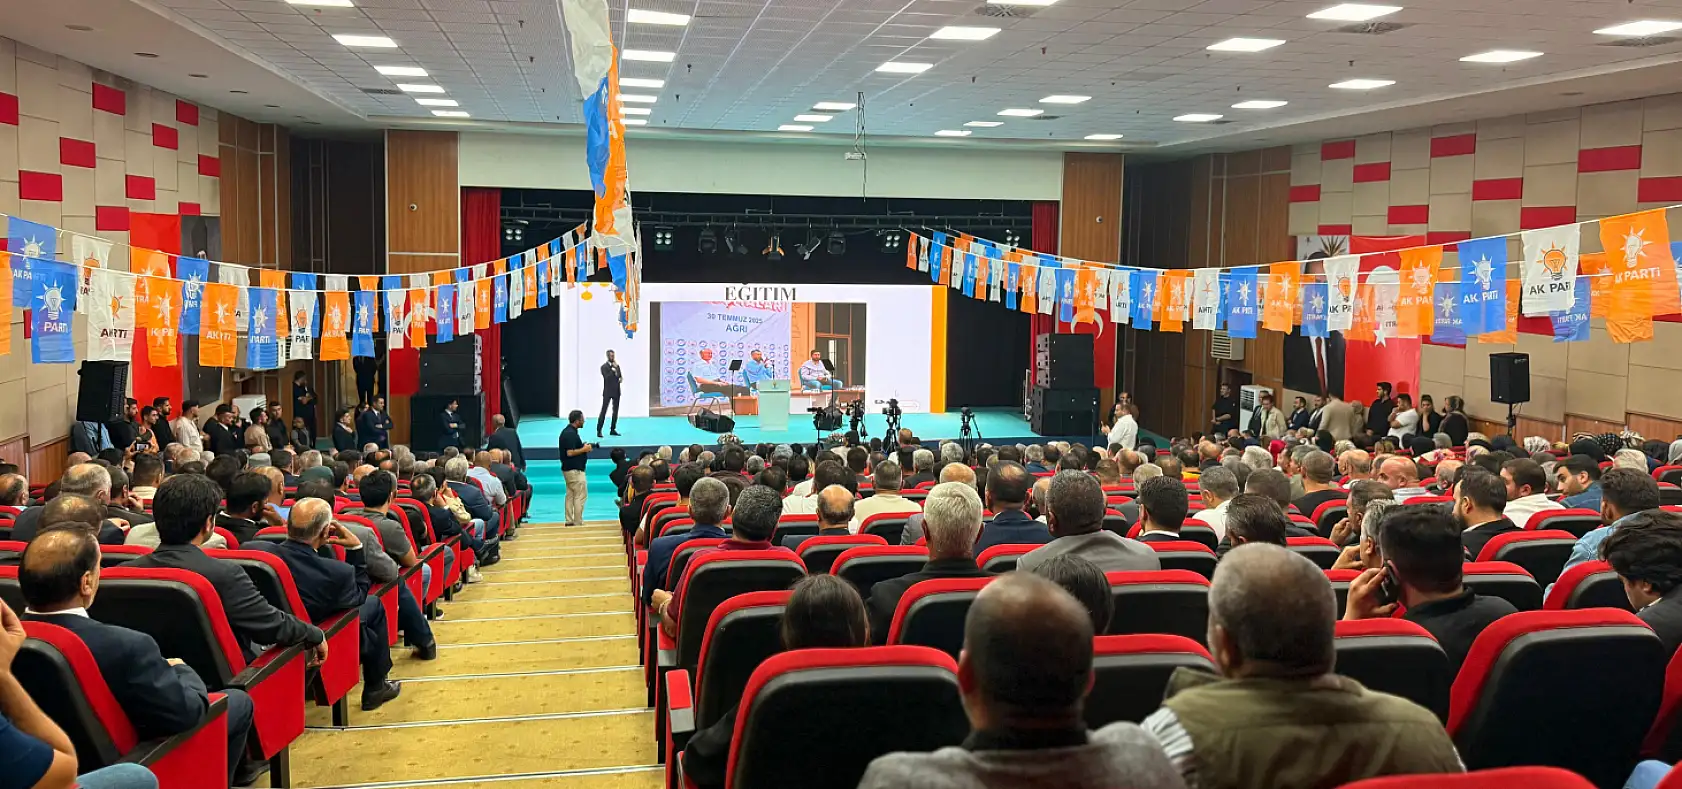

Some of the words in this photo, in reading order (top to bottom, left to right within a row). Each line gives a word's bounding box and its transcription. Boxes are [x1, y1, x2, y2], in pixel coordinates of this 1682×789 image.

[1529, 284, 1545, 295] AK
[1463, 292, 1480, 304] AK
[717, 313, 748, 323] TEMMUZ
[725, 323, 748, 333] AĞRI
